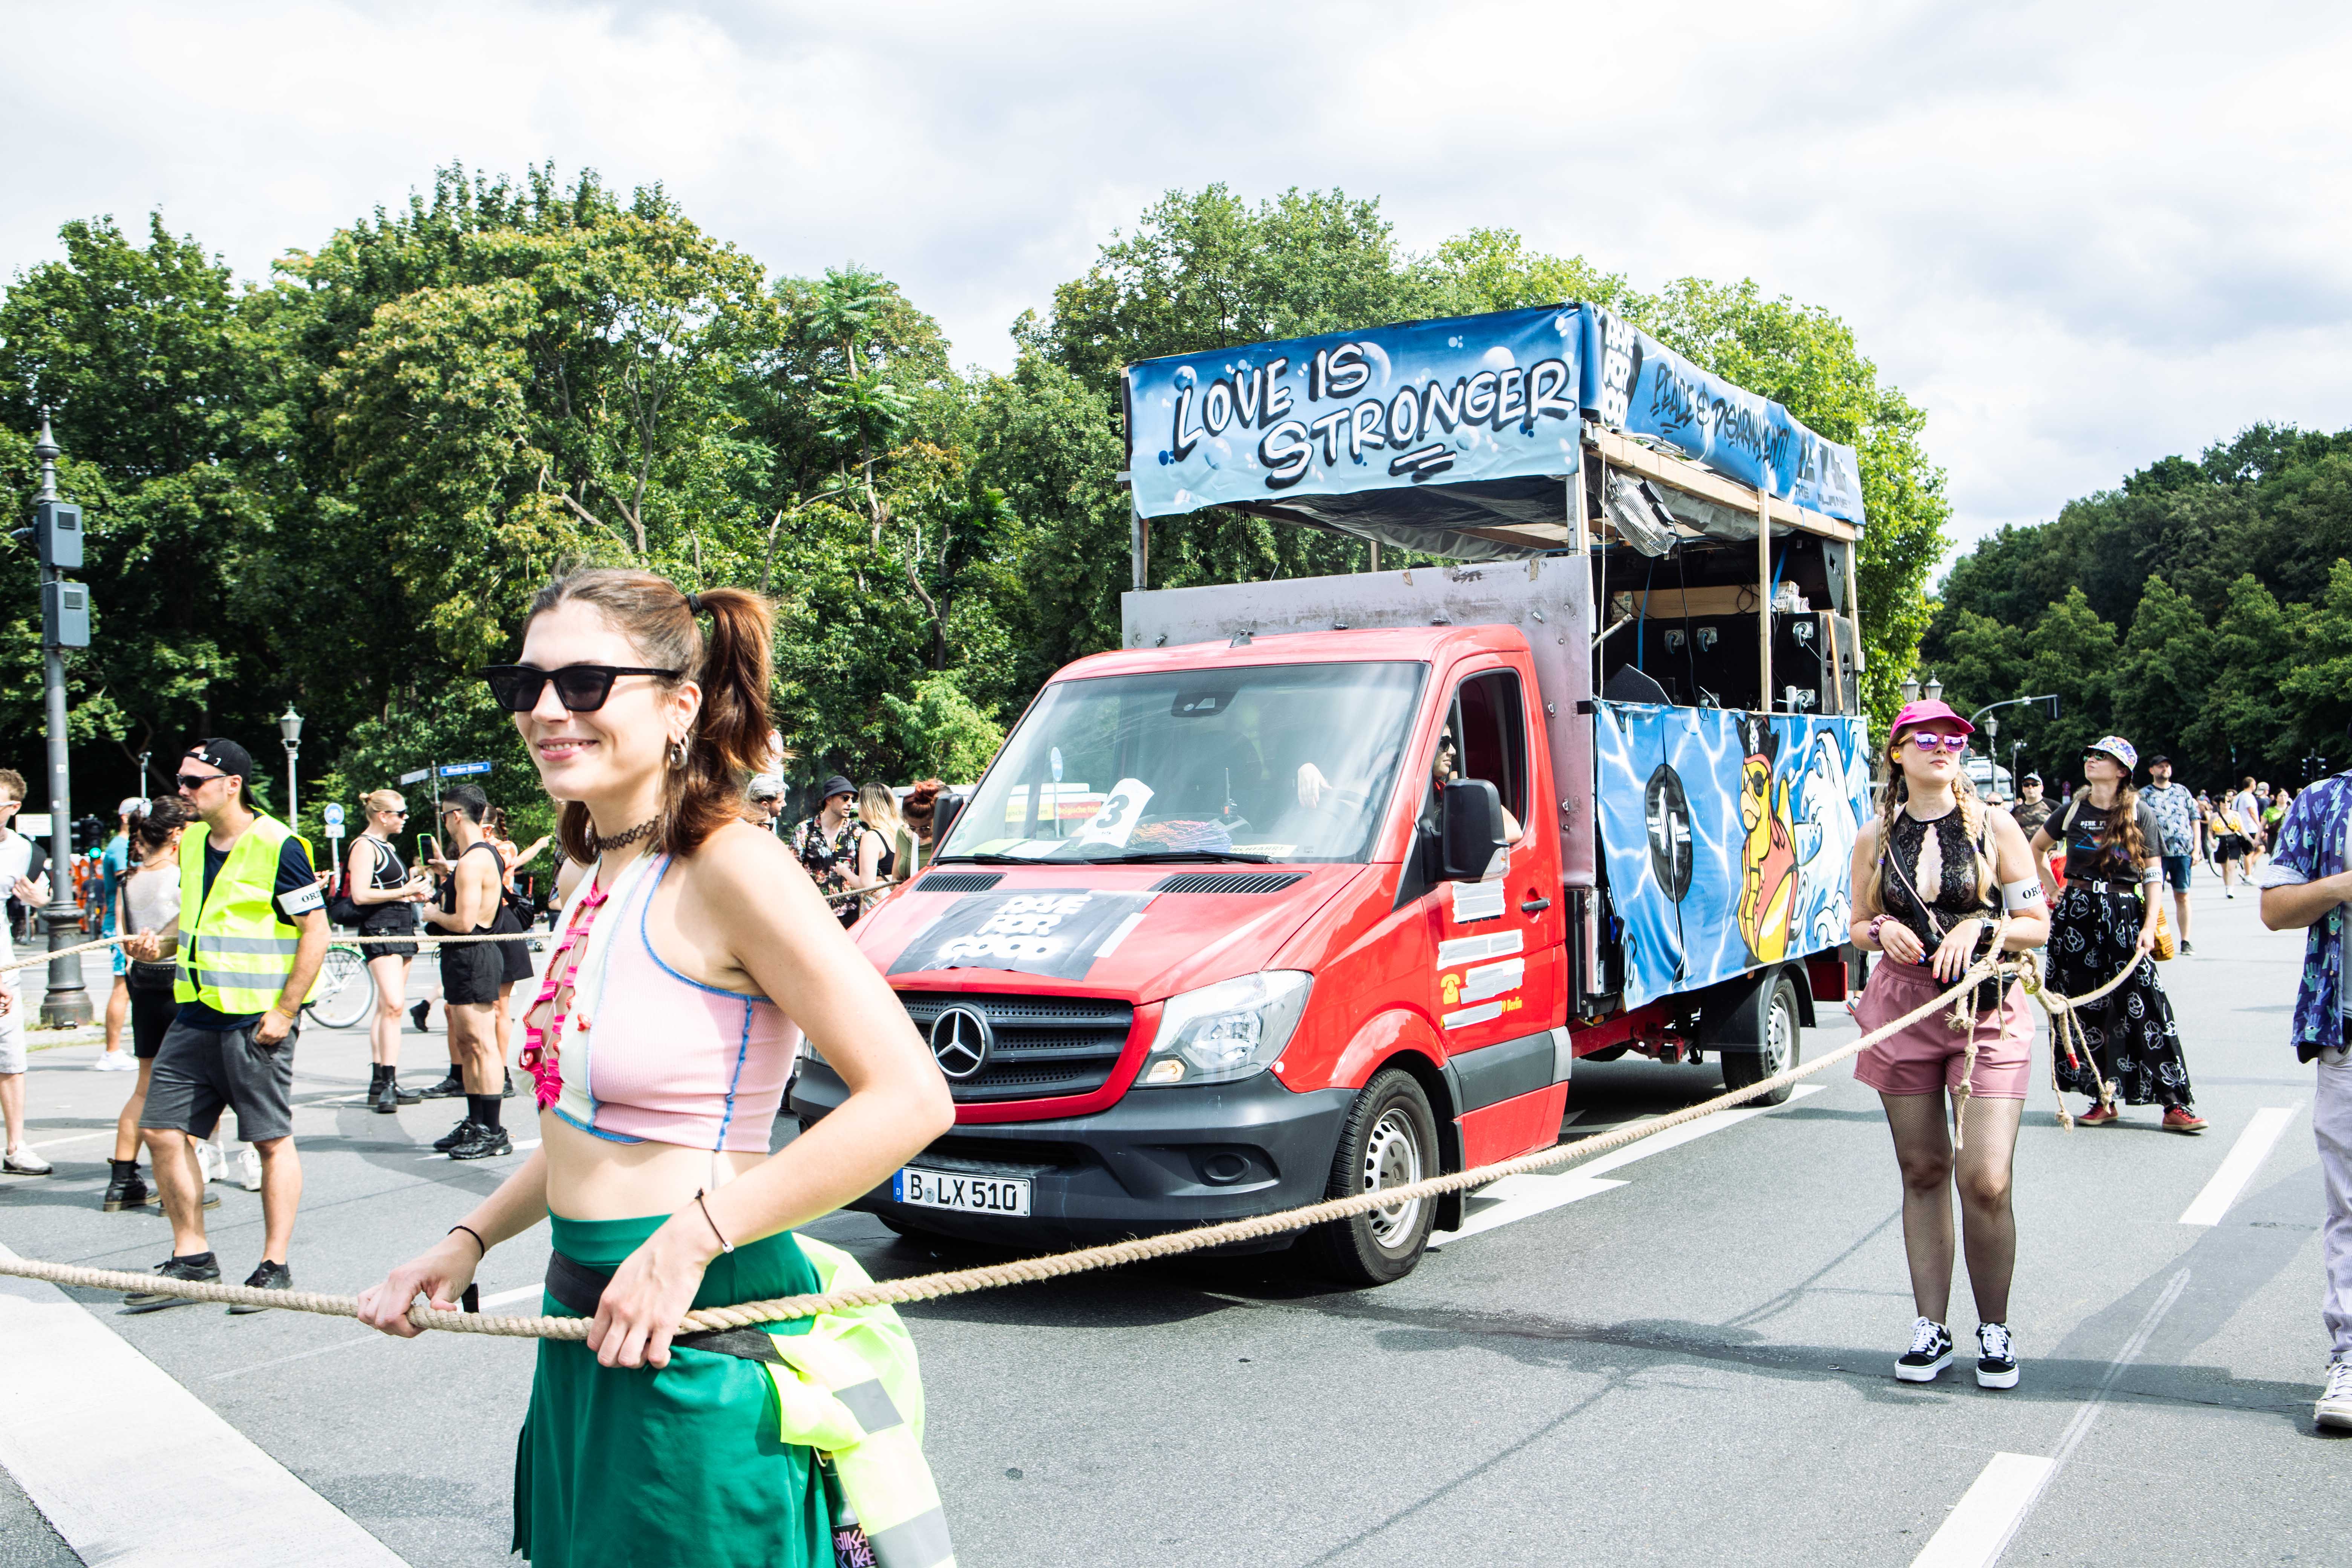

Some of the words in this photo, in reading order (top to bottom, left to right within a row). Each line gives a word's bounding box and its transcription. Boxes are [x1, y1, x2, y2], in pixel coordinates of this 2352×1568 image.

[1606, 312, 1635, 358] RAVE
[1603, 348, 1631, 392] FOR
[1173, 356, 1293, 462] LOVE
[1309, 342, 1371, 402] IS
[1602, 381, 1628, 430] OOD
[1650, 363, 1694, 427] PEACE
[1259, 359, 1576, 490] STRONGER
[1096, 795, 1130, 828] 3
[976, 913, 1063, 935] FOR
[997, 894, 1093, 914] RAVE
[938, 934, 1064, 961] GOOD
[1507, 996, 1522, 1012] Berlin
[911, 1173, 923, 1200] B
[938, 1177, 965, 1207] LX
[972, 1181, 1017, 1211] 510
